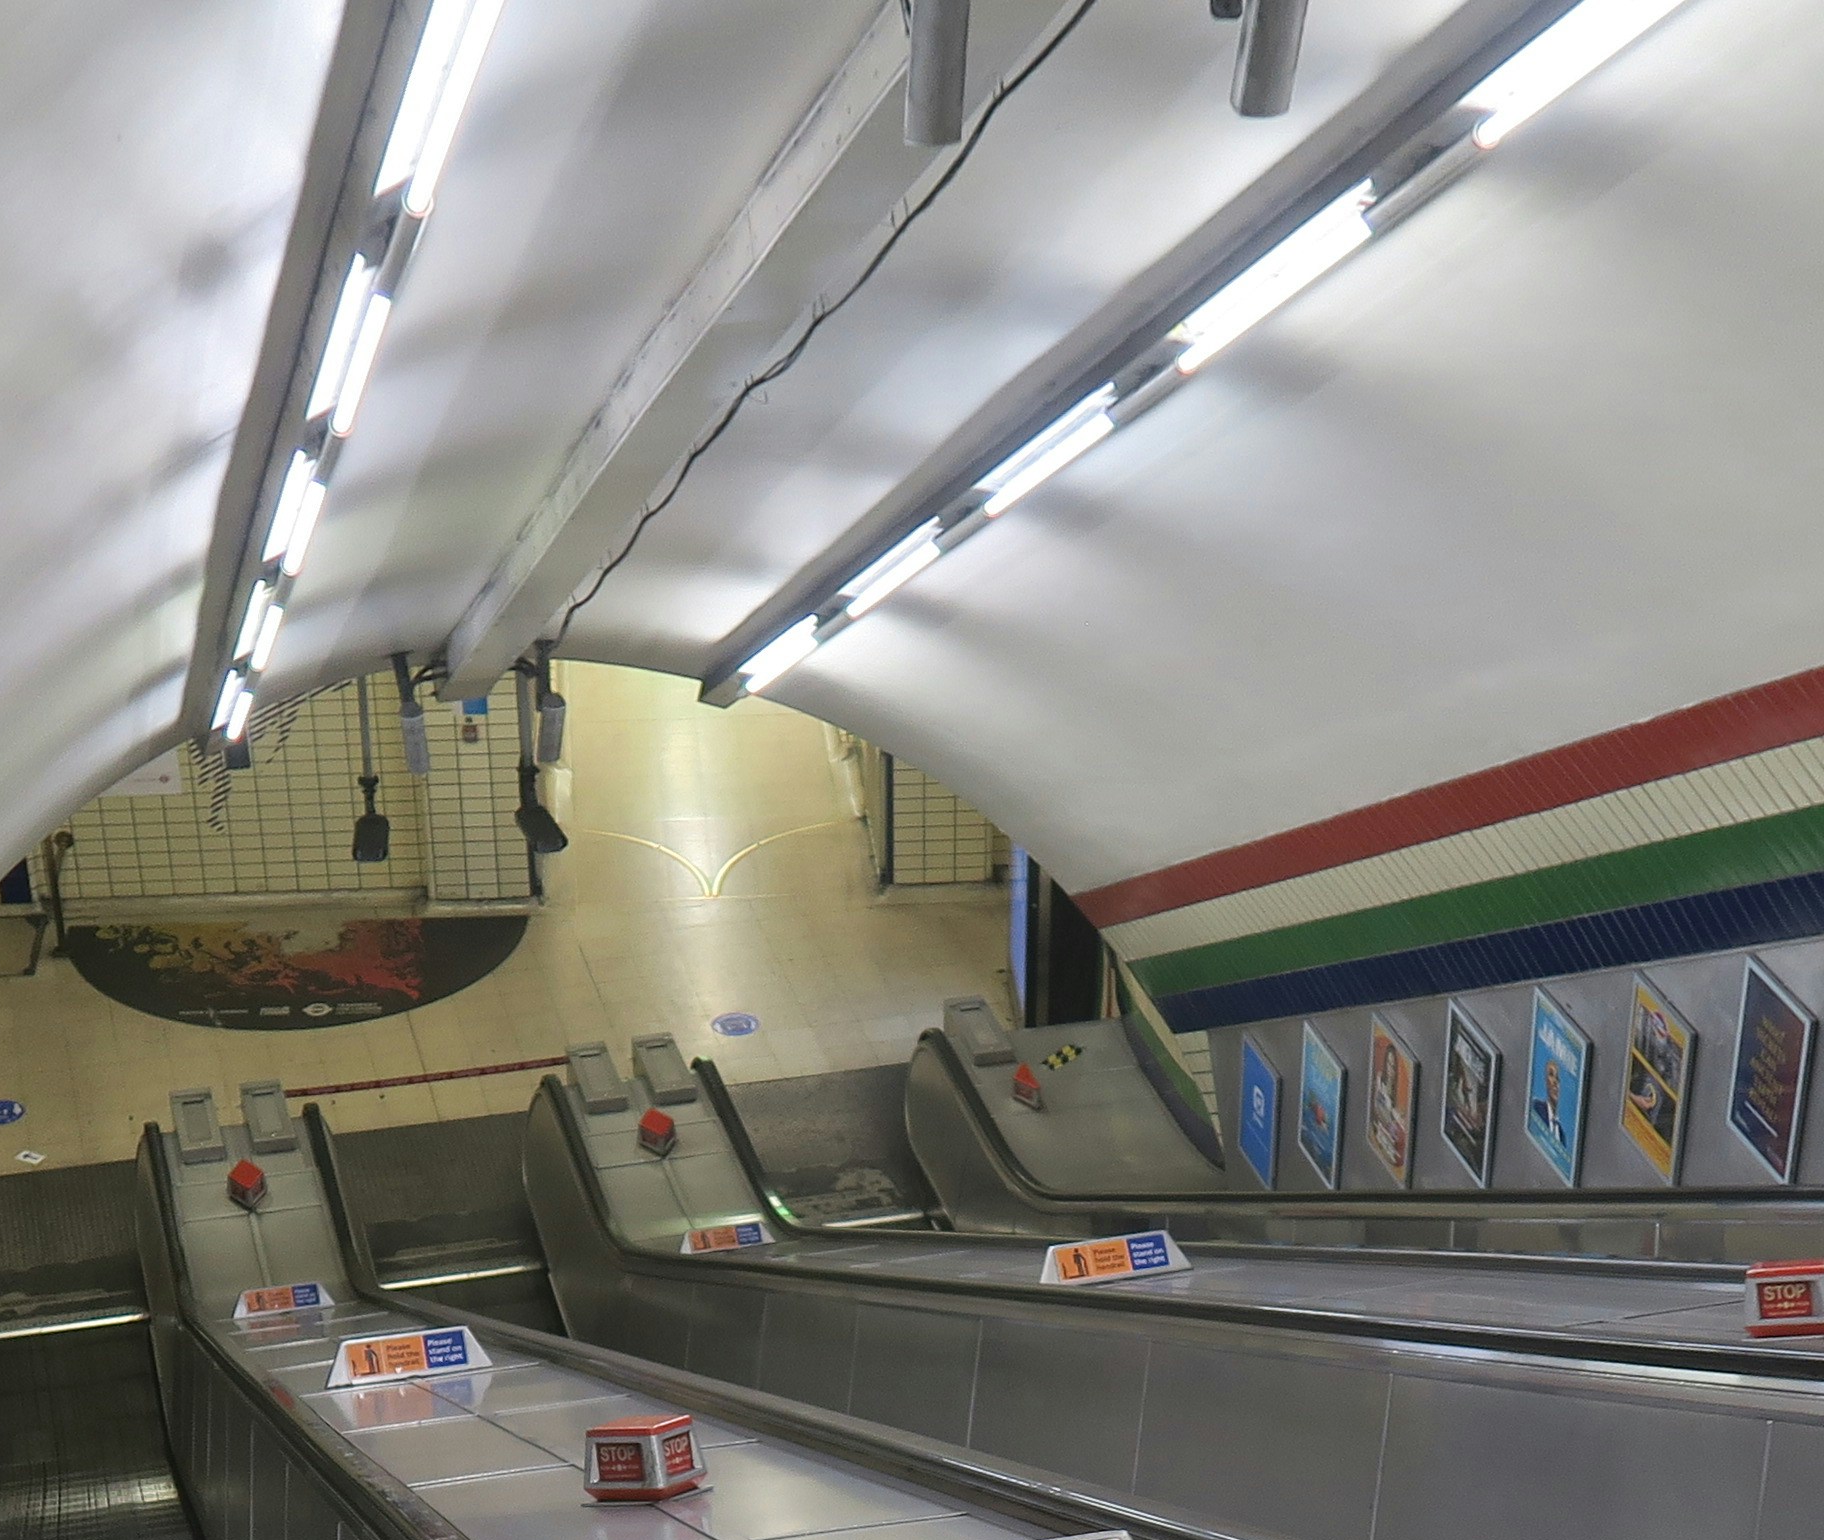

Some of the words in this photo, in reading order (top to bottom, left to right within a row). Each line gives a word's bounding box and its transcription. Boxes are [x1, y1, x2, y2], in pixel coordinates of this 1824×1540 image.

[1764, 1284, 1806, 1301] STOP
[600, 1446, 636, 1462] STOP
[664, 1436, 688, 1457] STOP
